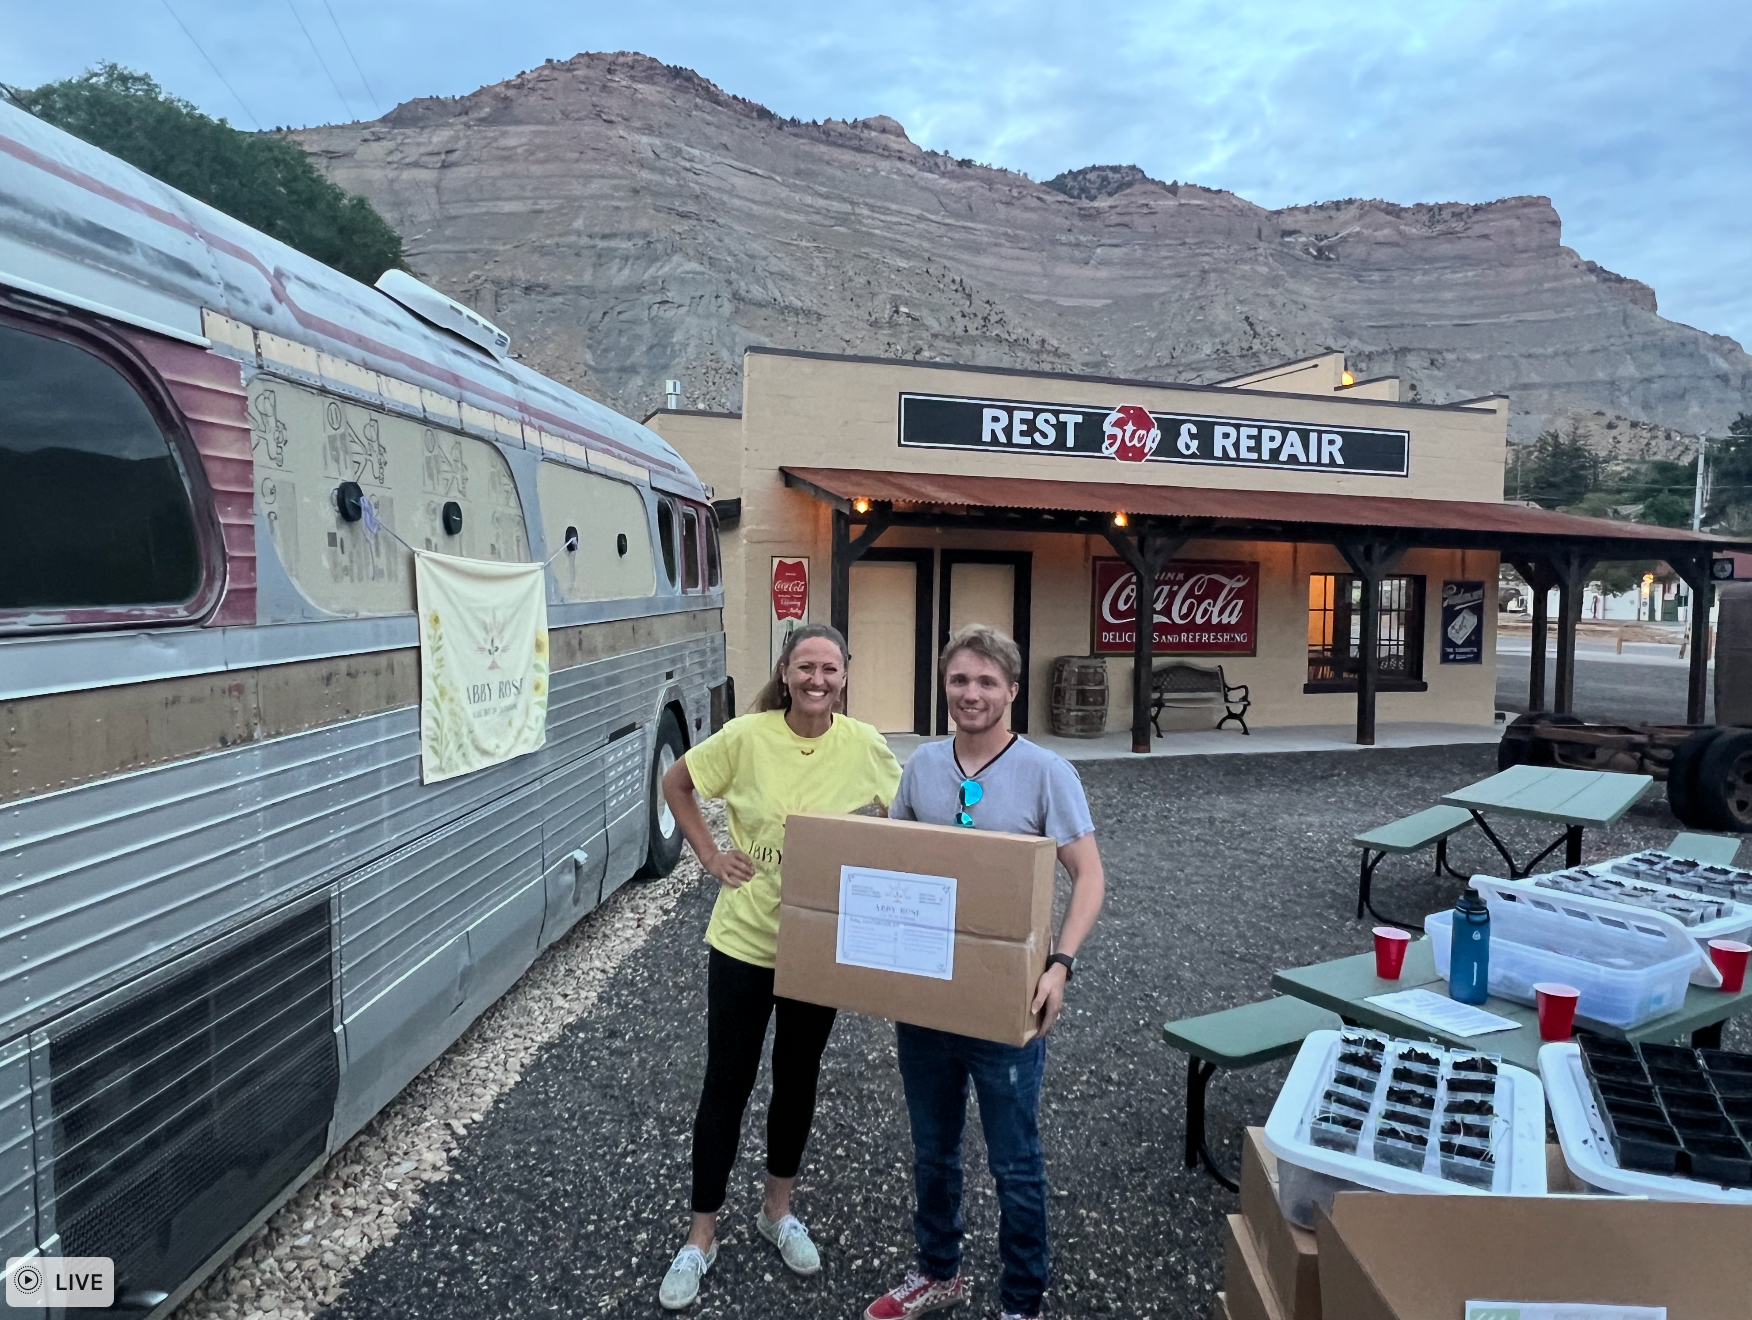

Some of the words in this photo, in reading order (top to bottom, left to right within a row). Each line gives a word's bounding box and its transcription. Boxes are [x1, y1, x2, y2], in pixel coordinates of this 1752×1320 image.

[982, 408, 1083, 447] REST
[1102, 412, 1161, 455] Stop
[1177, 423, 1200, 455] &
[1213, 425, 1345, 464] REPAIR
[1102, 572, 1249, 624] Coa-Cola
[1102, 632, 1159, 643] DELICIS
[1160, 634, 1179, 643] AND
[1181, 632, 1248, 643] REFRESHING
